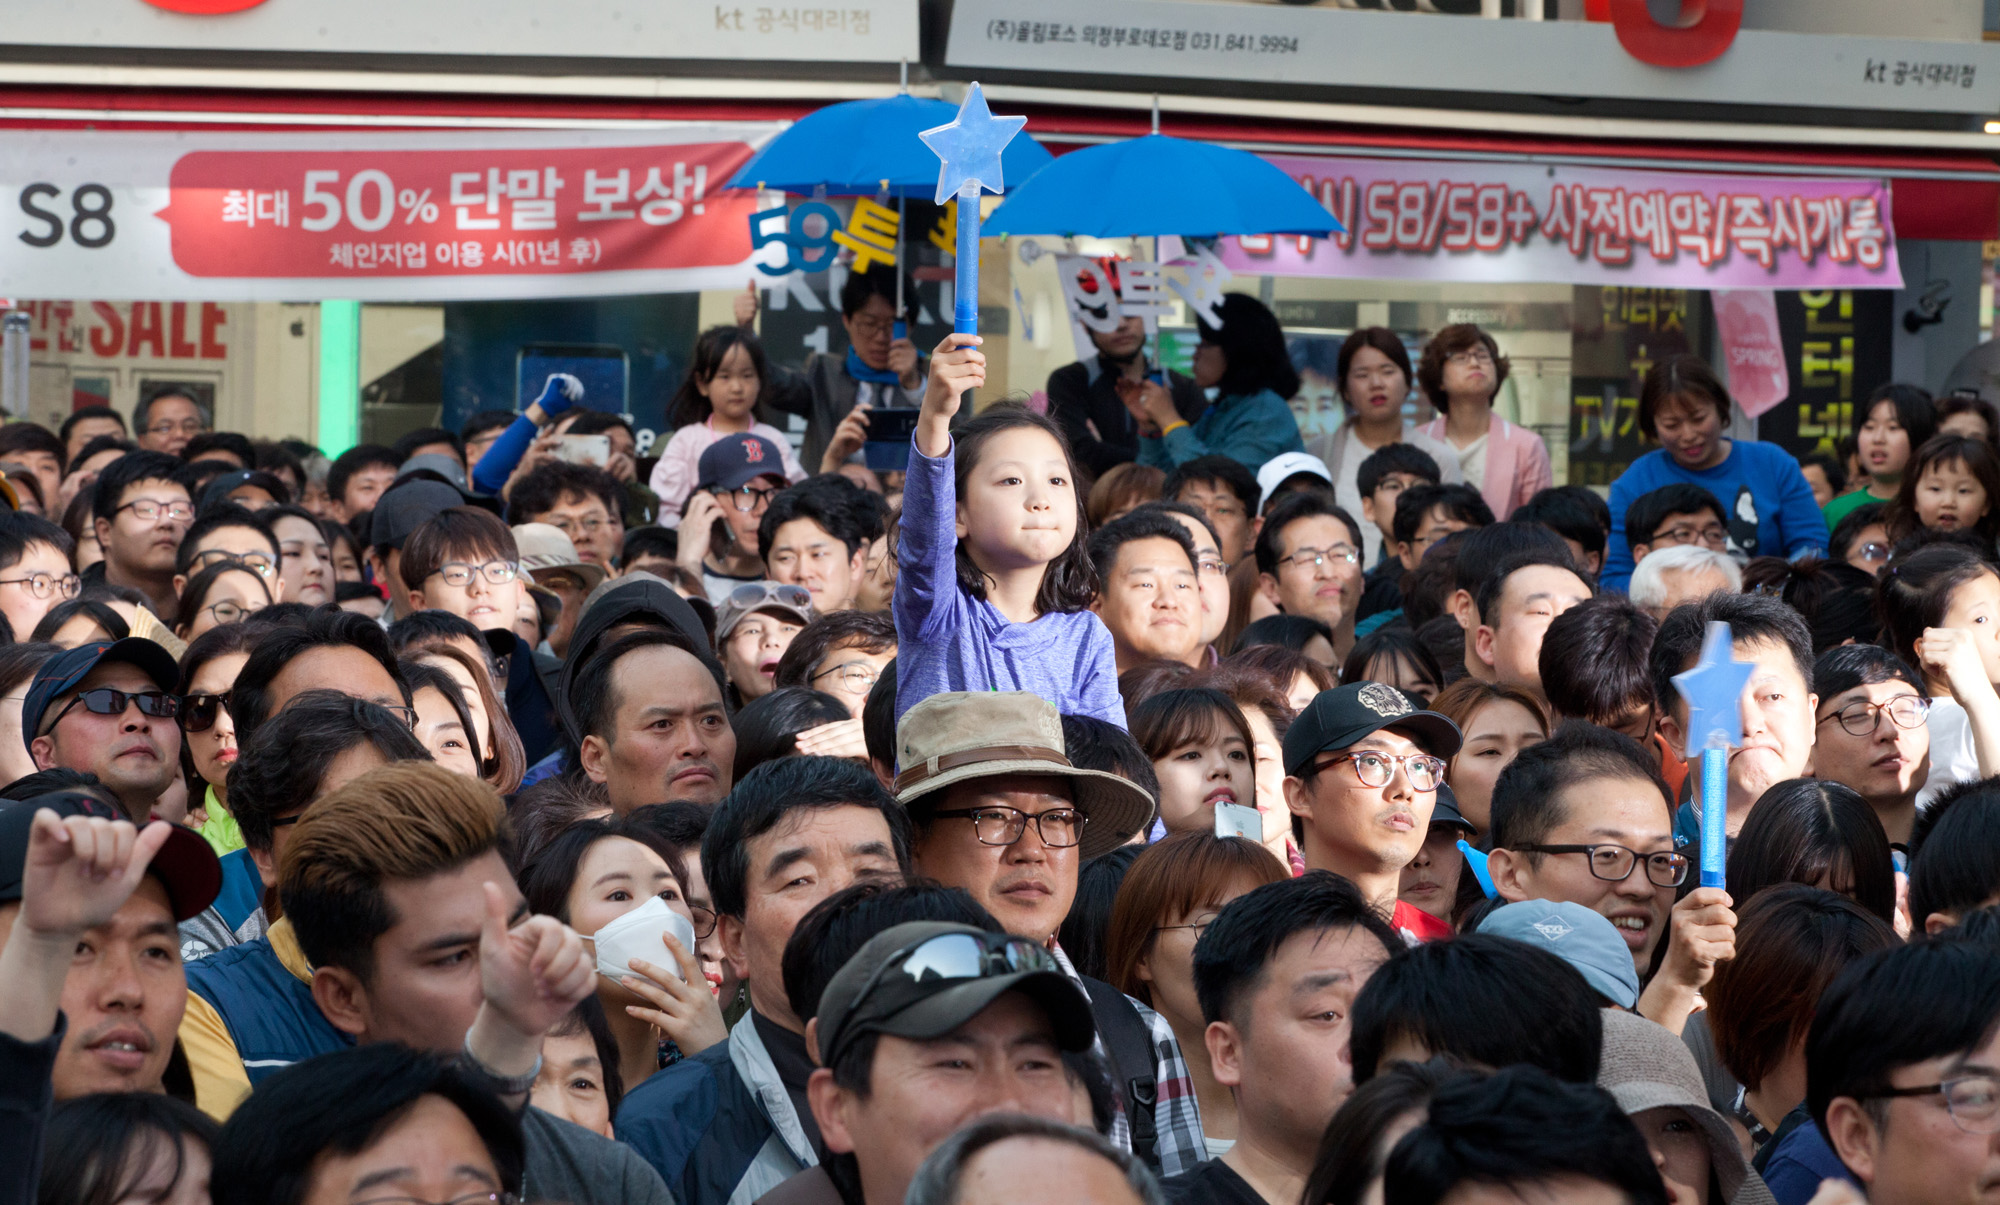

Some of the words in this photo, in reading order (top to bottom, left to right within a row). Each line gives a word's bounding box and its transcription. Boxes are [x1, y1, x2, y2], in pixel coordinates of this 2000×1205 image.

[714, 5, 746, 31] kt
[753, 7, 871, 35] 공식대리점
[1863, 57, 1888, 83] kt
[1892, 61, 1977, 89] 공식대리점
[18, 182, 116, 248] S8
[222, 189, 290, 228] 최대
[301, 169, 439, 232] 50%
[450, 167, 565, 231] 단말
[577, 162, 708, 227] 보상!
[329, 241, 427, 270] 체인지업
[434, 241, 486, 269] 이용
[567, 237, 602, 266] 후)
[88, 301, 228, 360] SALE
